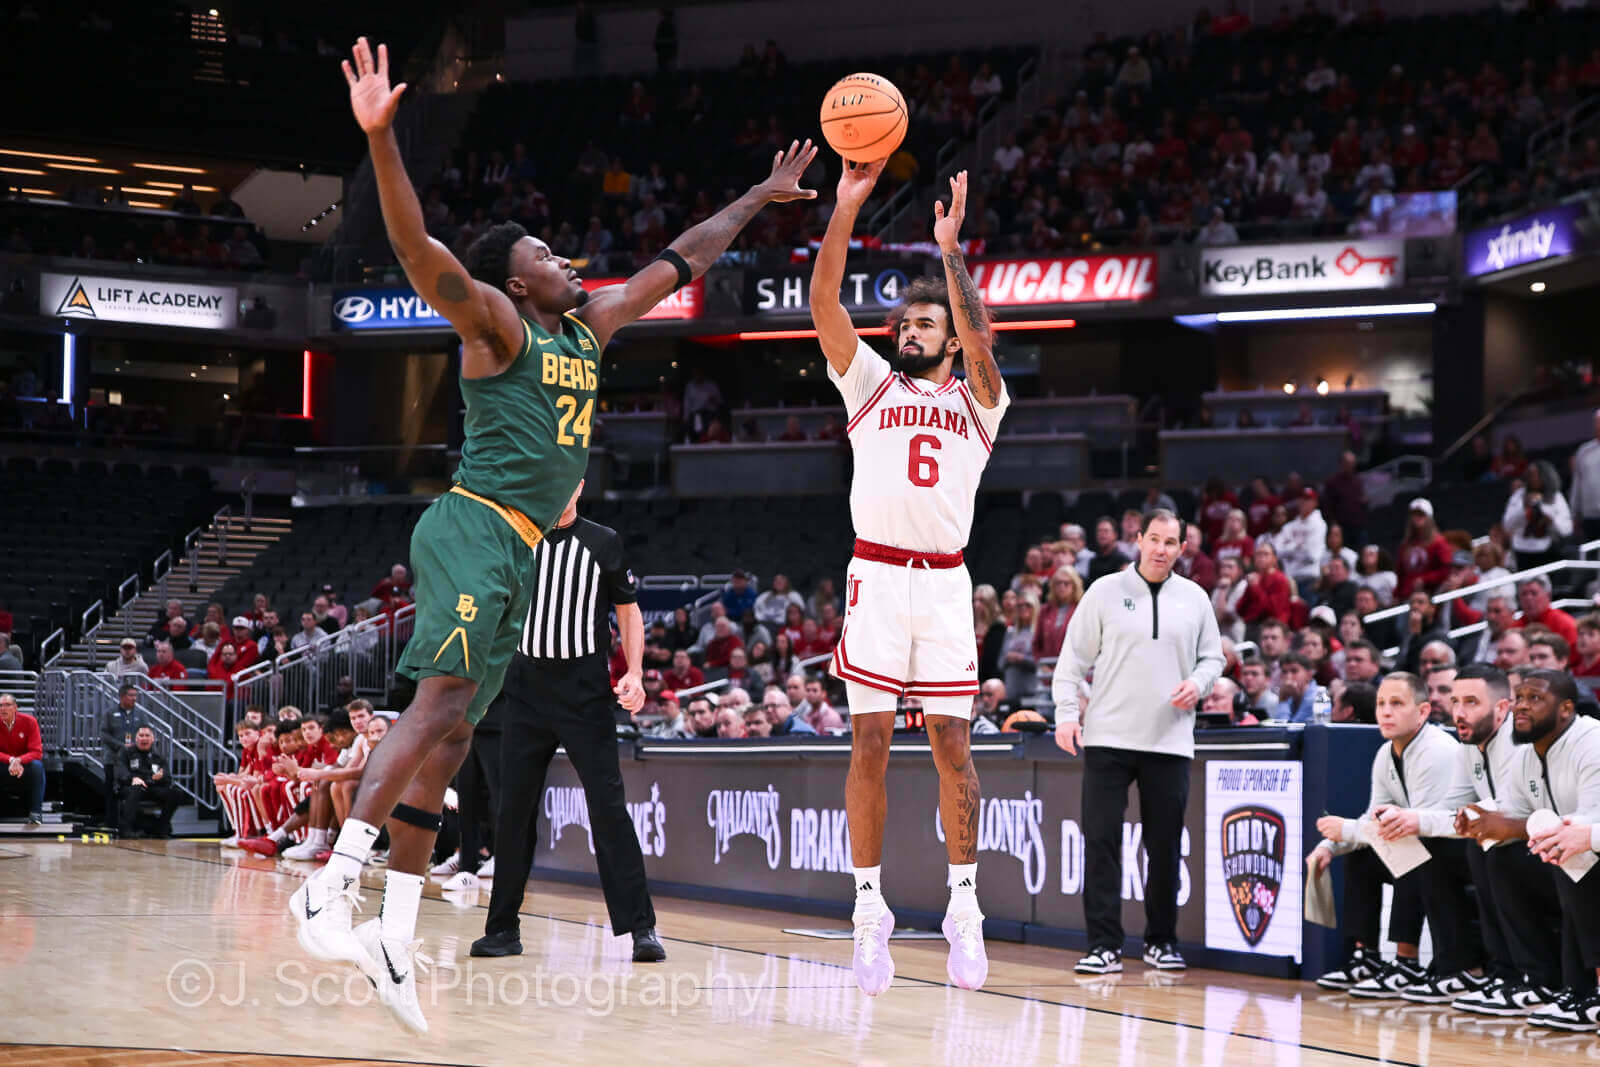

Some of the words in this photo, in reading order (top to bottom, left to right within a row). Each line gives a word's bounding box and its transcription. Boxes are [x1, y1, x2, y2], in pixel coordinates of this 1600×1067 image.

[971, 260, 1089, 301] LUCAS
[1093, 257, 1154, 299] OIL
[1204, 255, 1327, 286] KeyBank
[98, 287, 133, 303] LIFT
[137, 290, 222, 309] ACADEMY
[556, 395, 594, 448] 24
[879, 405, 968, 440] INDIANA
[908, 433, 942, 487] 6
[1218, 768, 1242, 791] PROUD
[707, 784, 781, 869] MALONE'S
[790, 808, 853, 873] DRAK
[936, 790, 1046, 894] LONE'S
[1228, 818, 1277, 855] INDY
[1225, 853, 1282, 881] SHOWDOWN
